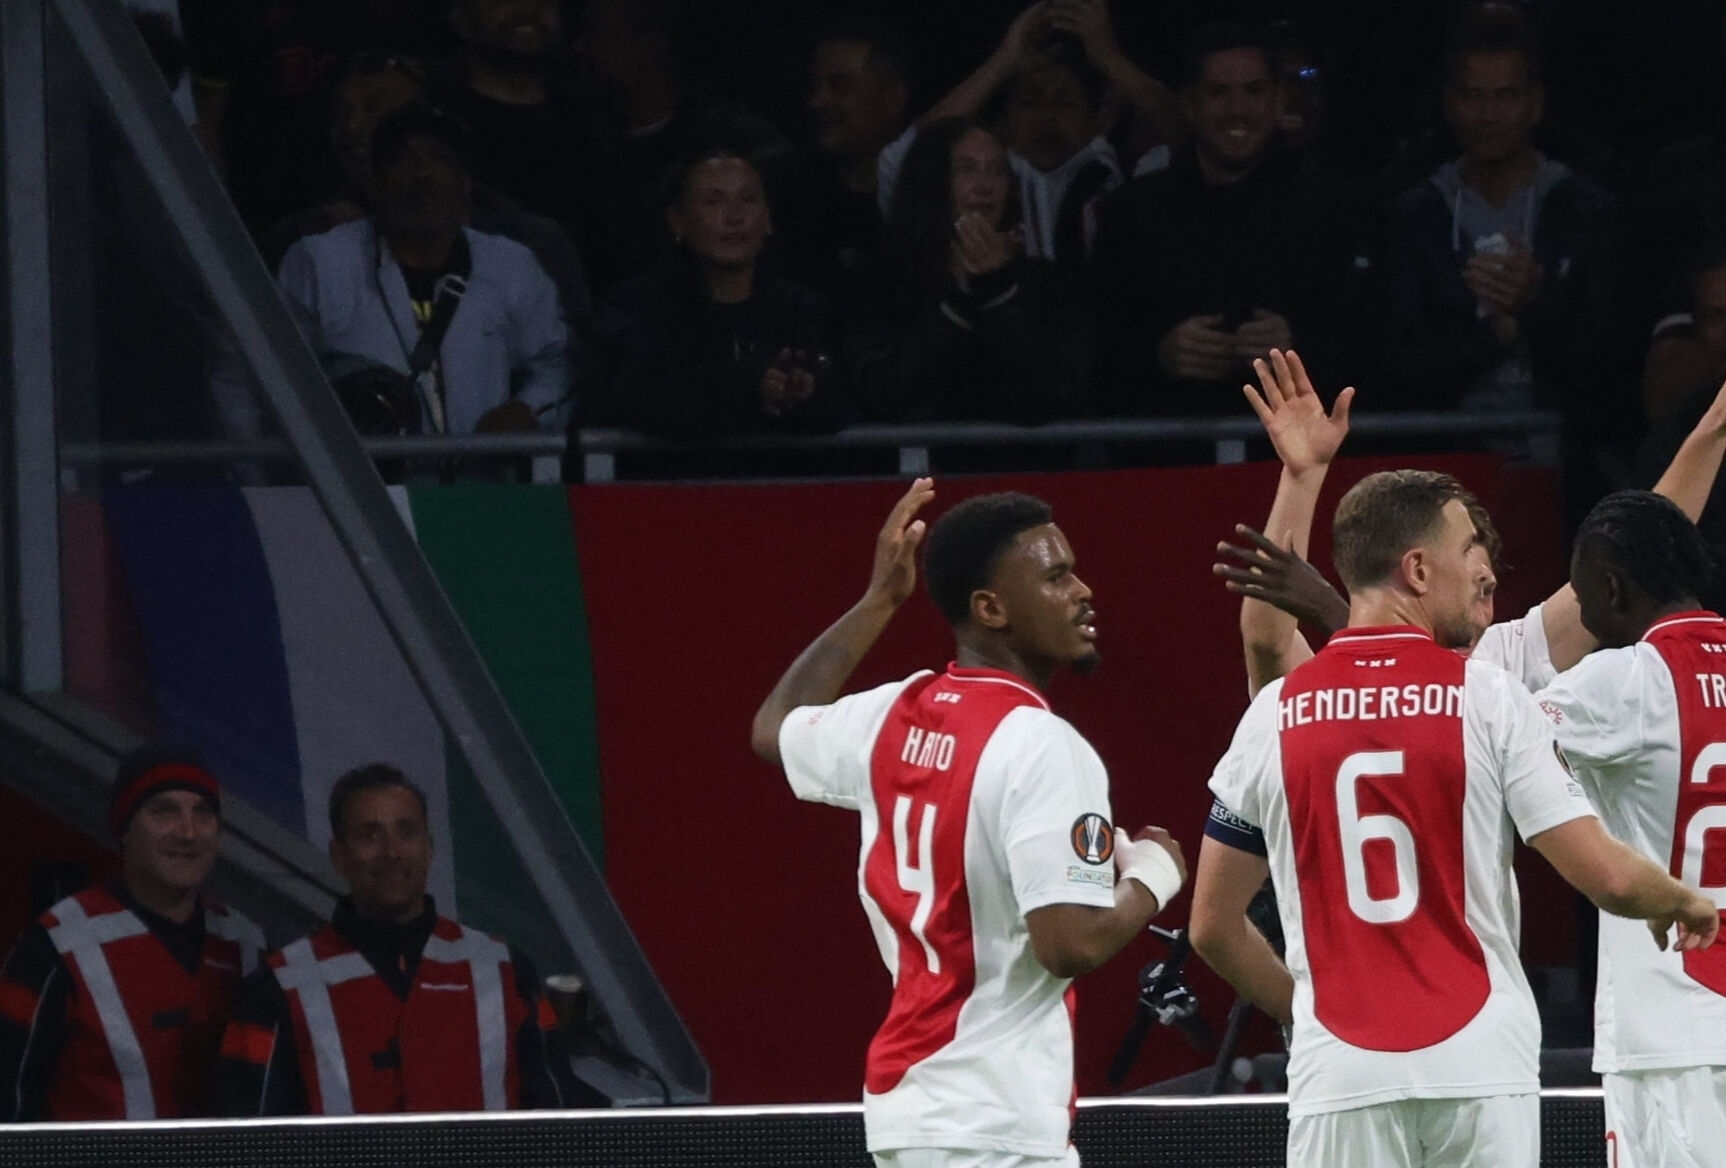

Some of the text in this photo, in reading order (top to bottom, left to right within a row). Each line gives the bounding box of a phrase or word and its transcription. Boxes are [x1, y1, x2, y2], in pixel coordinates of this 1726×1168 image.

[1278, 684, 1465, 731] HENDERSON
[893, 795, 941, 975] 4
[1336, 751, 1420, 924] 6
